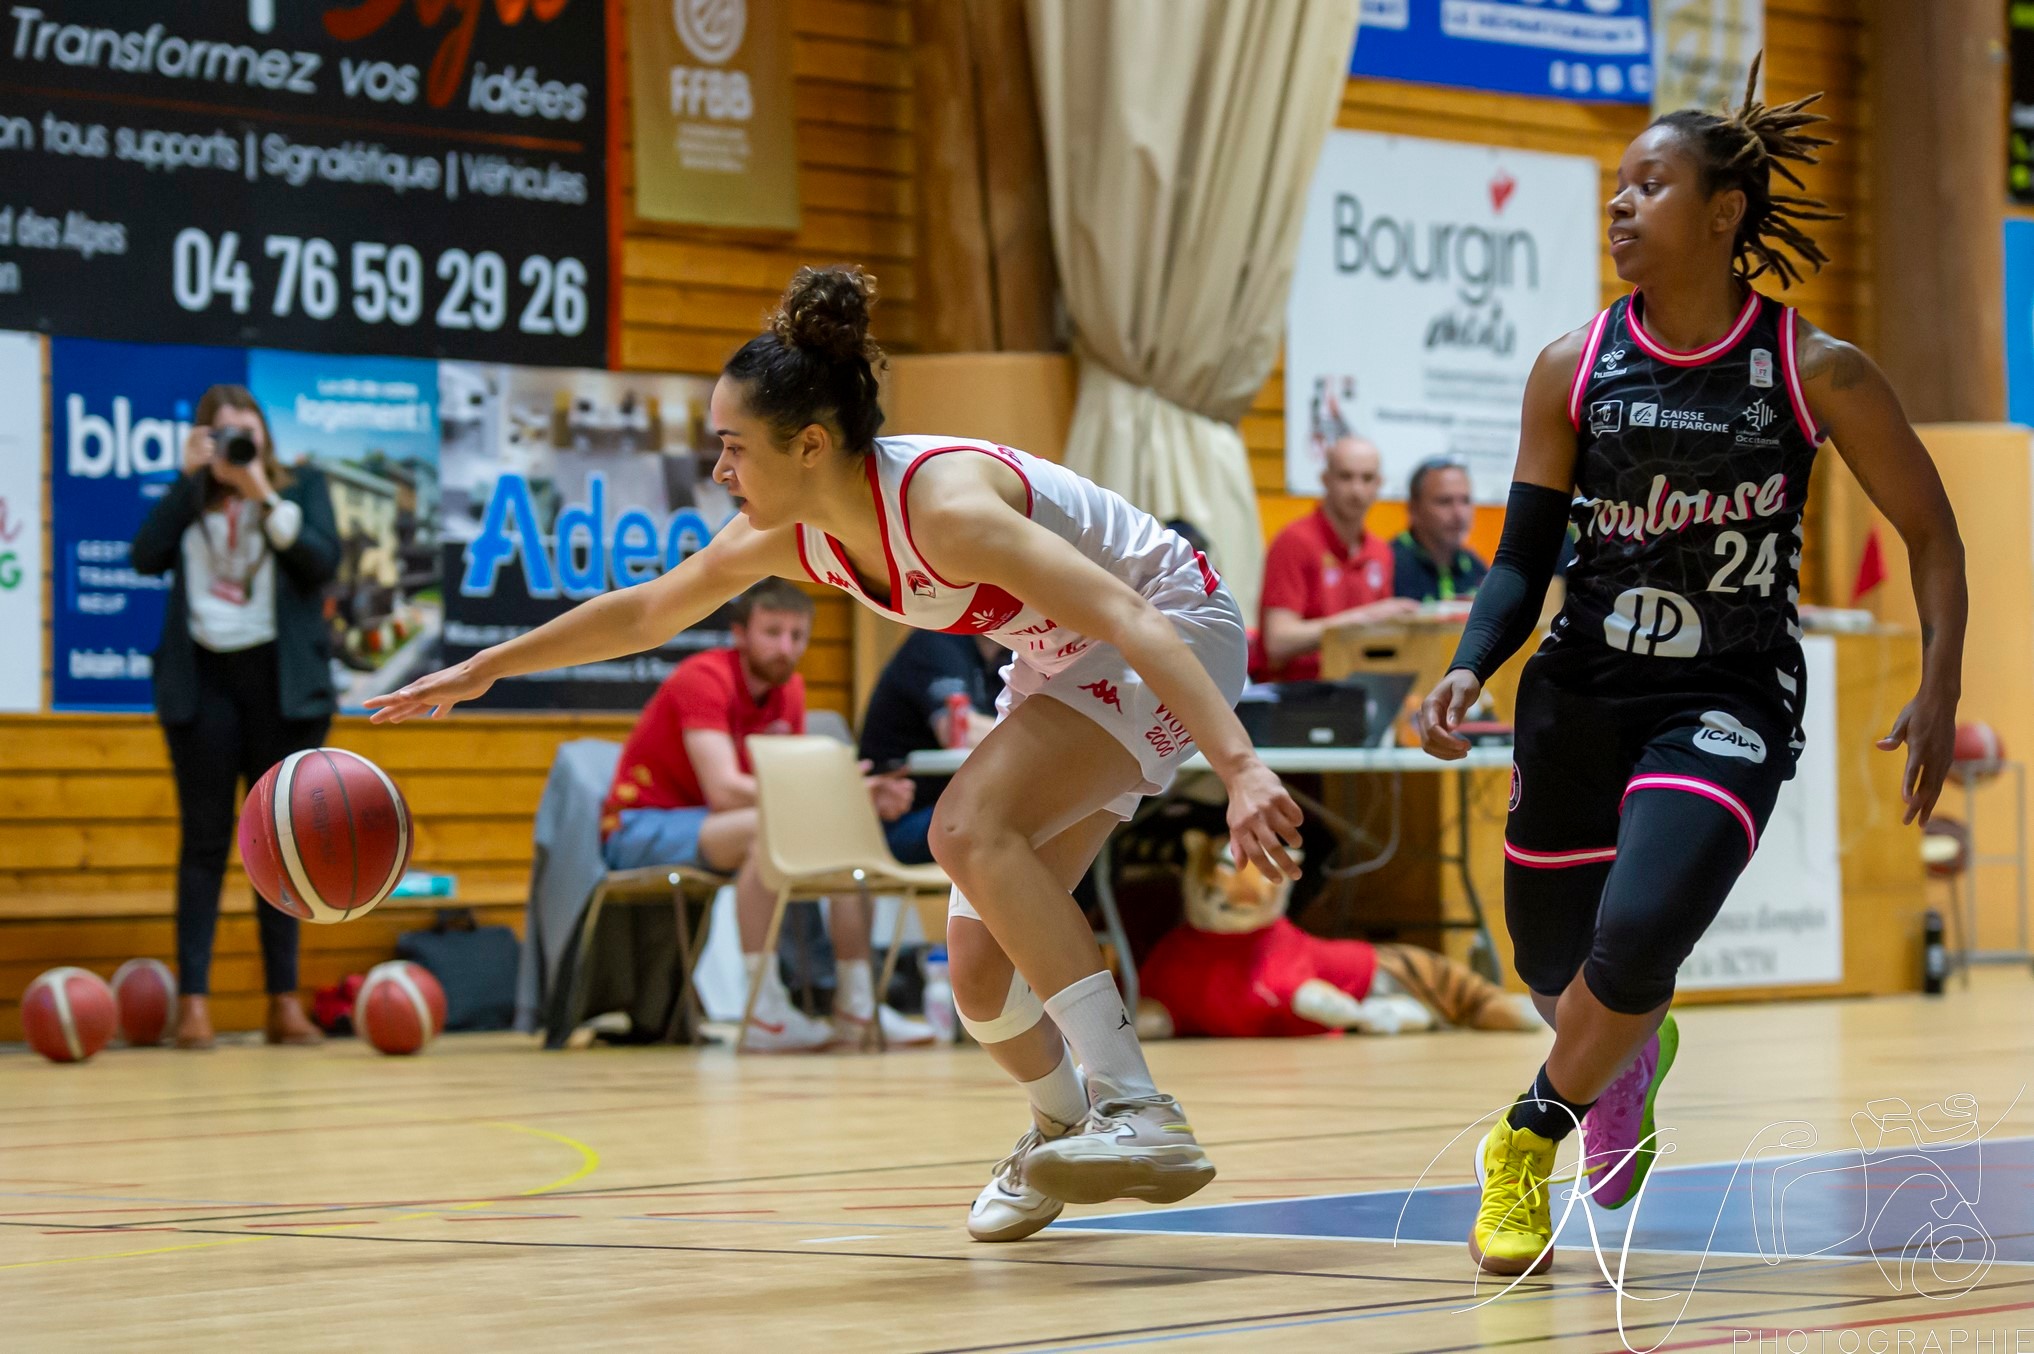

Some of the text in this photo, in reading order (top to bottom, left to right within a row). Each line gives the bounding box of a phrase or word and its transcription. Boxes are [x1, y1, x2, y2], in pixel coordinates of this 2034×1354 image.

[10, 6, 321, 94] Transformez
[340, 56, 420, 104] vos
[468, 61, 588, 122] idées
[42, 110, 109, 158] tous
[114, 126, 241, 172] supports
[172, 226, 589, 337] 04 76 59 29 26
[1334, 191, 1540, 306] Bourgin
[1660, 420, 1730, 434] D'EPARGNE
[1661, 408, 1705, 421] CAISSE
[1572, 473, 1787, 545] Toulouse
[1706, 530, 1779, 597] 24
[1144, 725, 1175, 757] 2000
